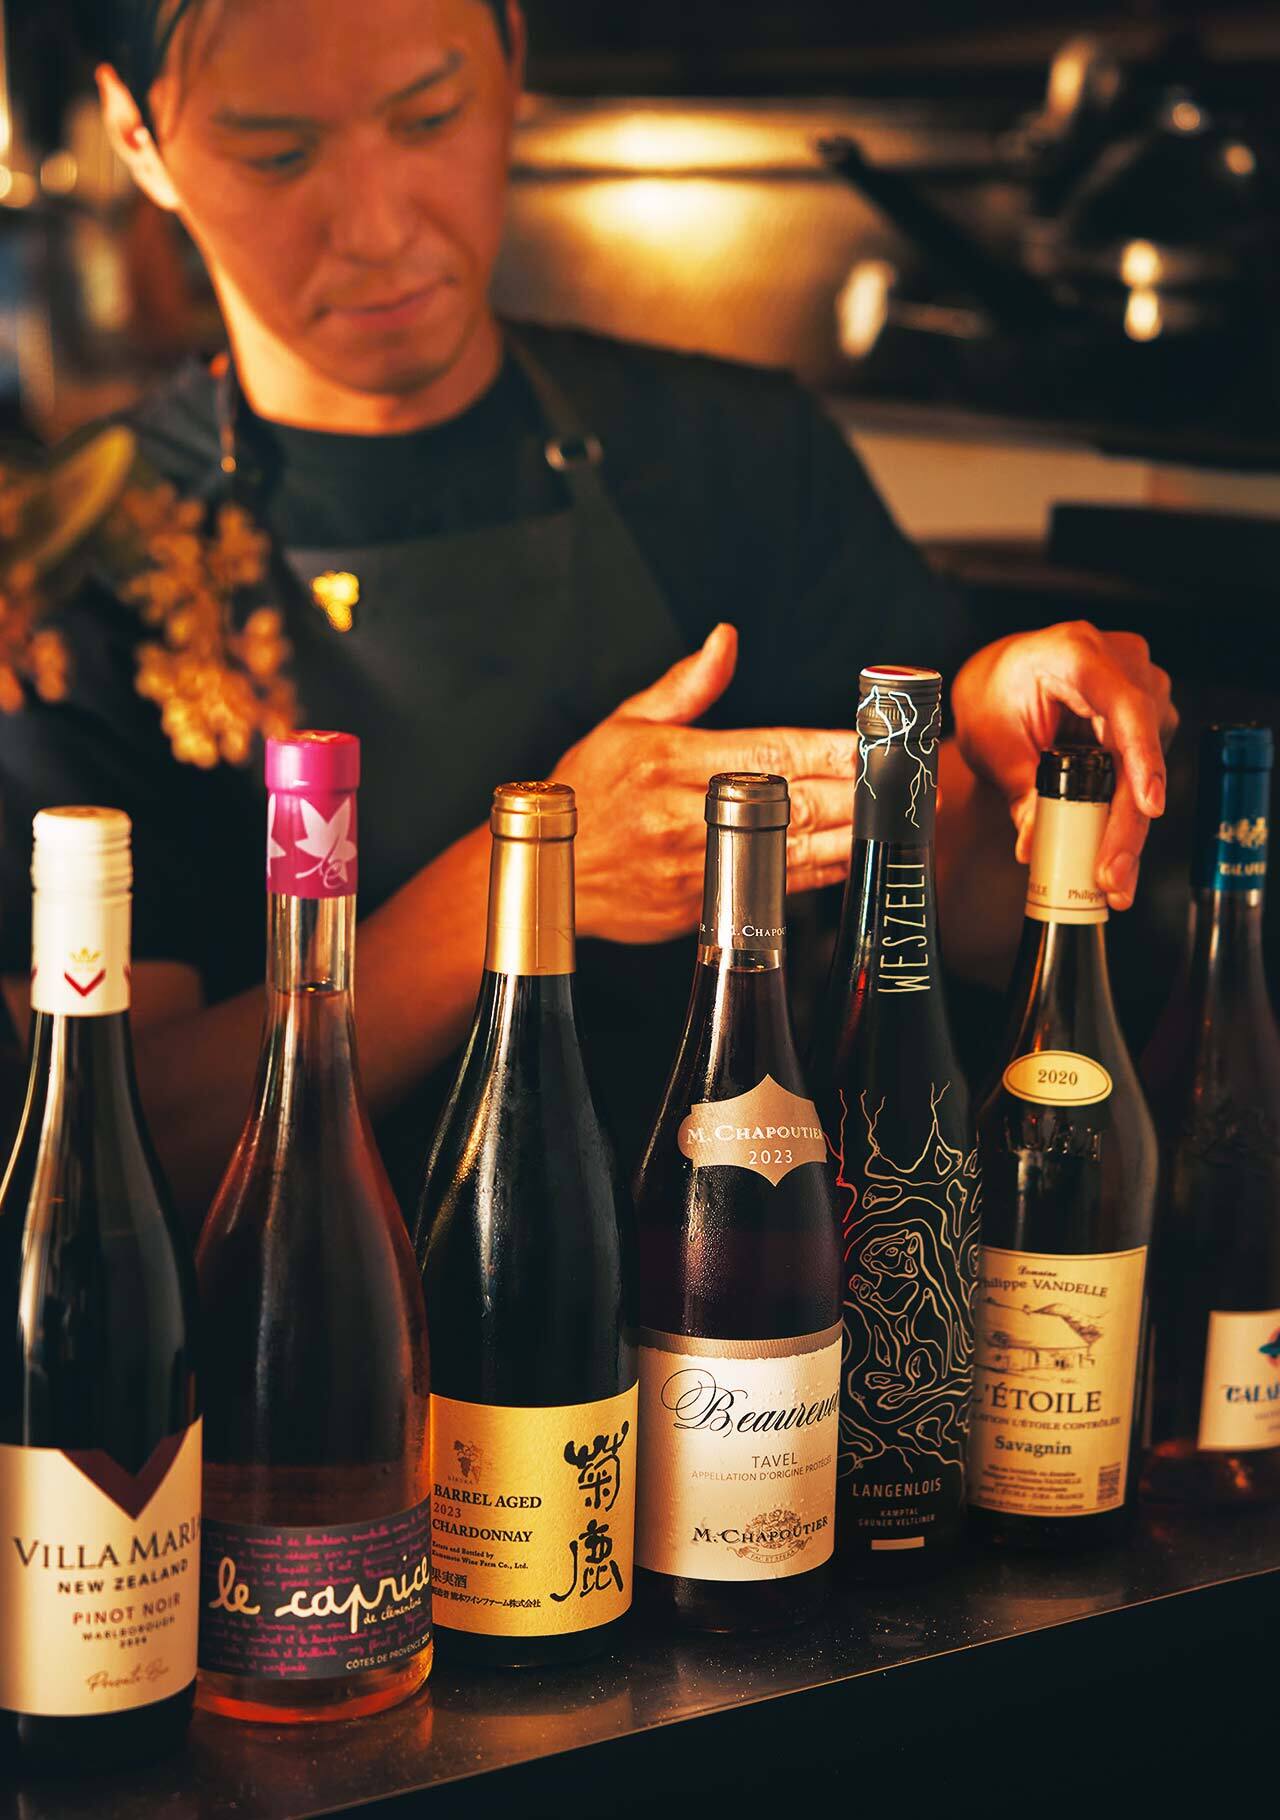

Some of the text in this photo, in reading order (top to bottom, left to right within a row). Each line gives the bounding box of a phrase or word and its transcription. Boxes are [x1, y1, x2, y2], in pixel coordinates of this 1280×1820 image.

[877, 863, 932, 994] WESZELI
[1037, 1069, 1078, 1086] 2020
[749, 1150, 793, 1164] 2023
[982, 1278, 1109, 1298] hilippe VANDELLE
[976, 1382, 1102, 1413] 'ÉTOILE
[994, 1435, 1073, 1457] Savagnin
[751, 1452, 798, 1468] TAVEL
[691, 1470, 757, 1481] APPELLATION
[759, 1467, 804, 1481] D'ORIGINE
[433, 1484, 542, 1509] BARREL AGED
[852, 1478, 942, 1497] LANGENLOIS
[433, 1502, 462, 1519] 2023
[13, 1536, 120, 1569] VILLA
[129, 1514, 200, 1564] MARI
[432, 1518, 533, 1543] CHARDONNAY
[718, 1516, 829, 1544] CHAPOUTIER
[58, 1558, 189, 1595] NEW ZEALAND
[208, 1556, 261, 1616] le
[73, 1592, 181, 1625] PINOT NOIR
[363, 1612, 378, 1625] de
